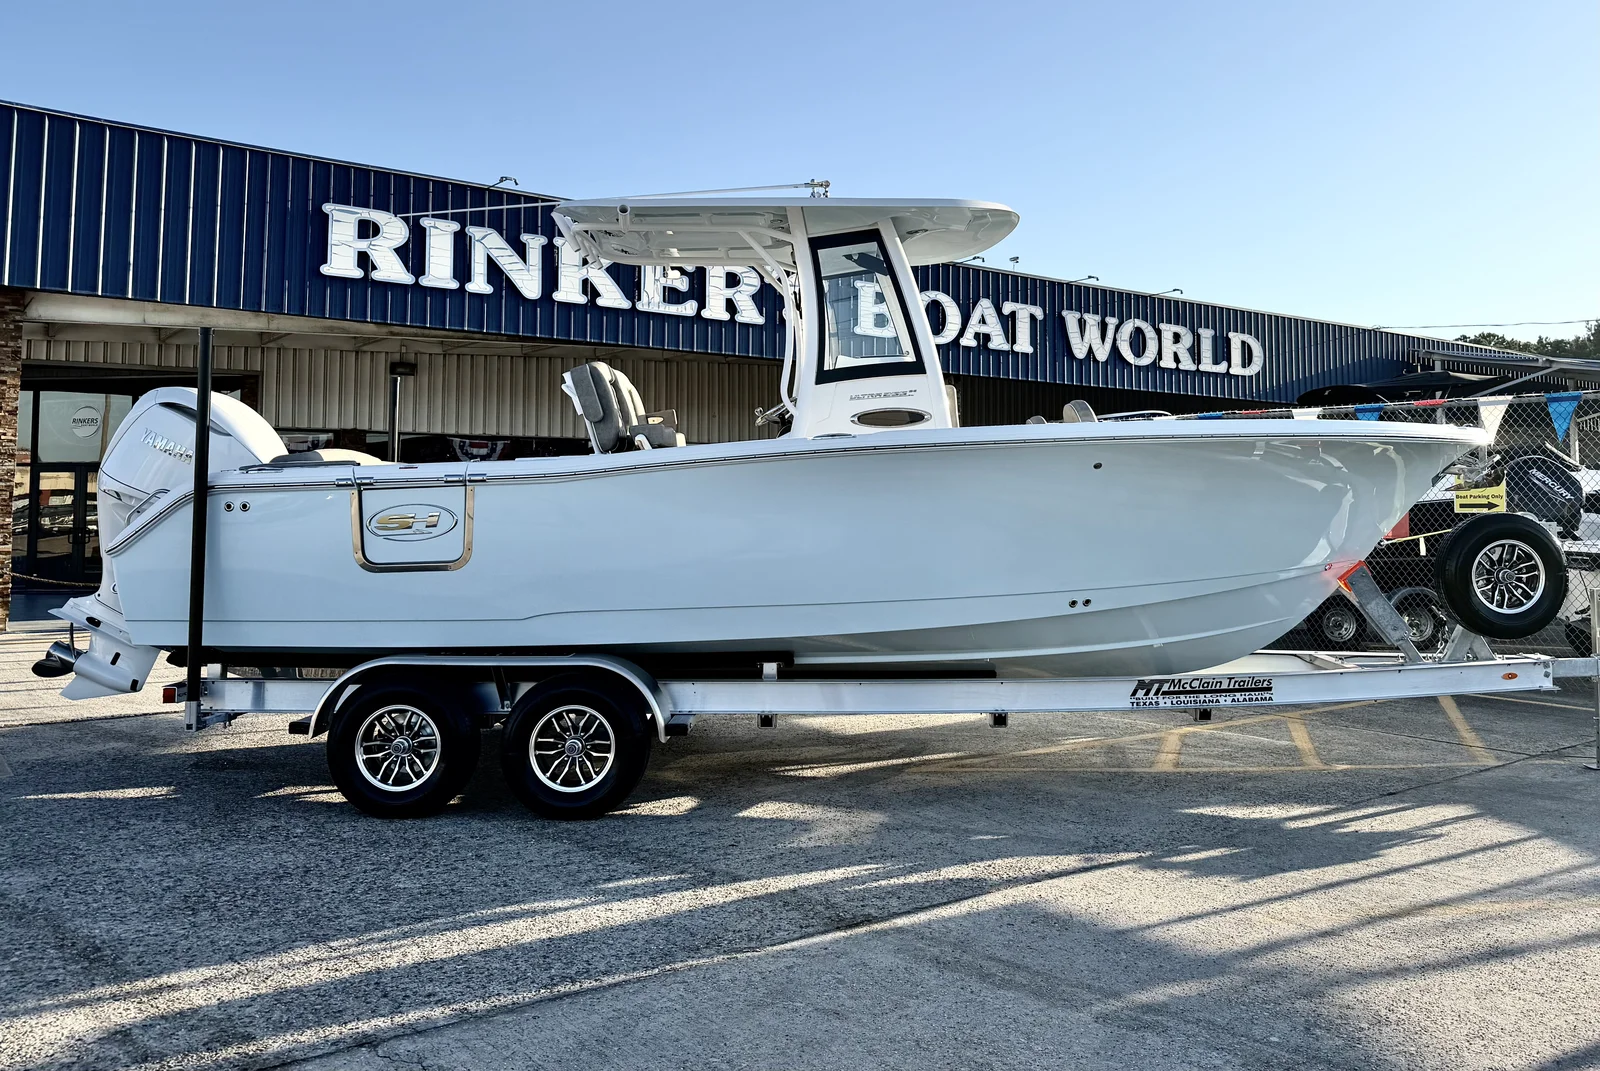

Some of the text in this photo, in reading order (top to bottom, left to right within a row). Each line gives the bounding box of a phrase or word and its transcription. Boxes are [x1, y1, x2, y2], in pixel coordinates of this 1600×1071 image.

[853, 280, 1044, 354] BOAT
[1061, 309, 1264, 376] WORLD
[140, 427, 194, 465] YAMAHA
[1528, 468, 1575, 500] MERCURY
[1168, 678, 1223, 690] McClain
[1226, 676, 1273, 688] Trailers
[1170, 698, 1221, 706] LOUISIANA
